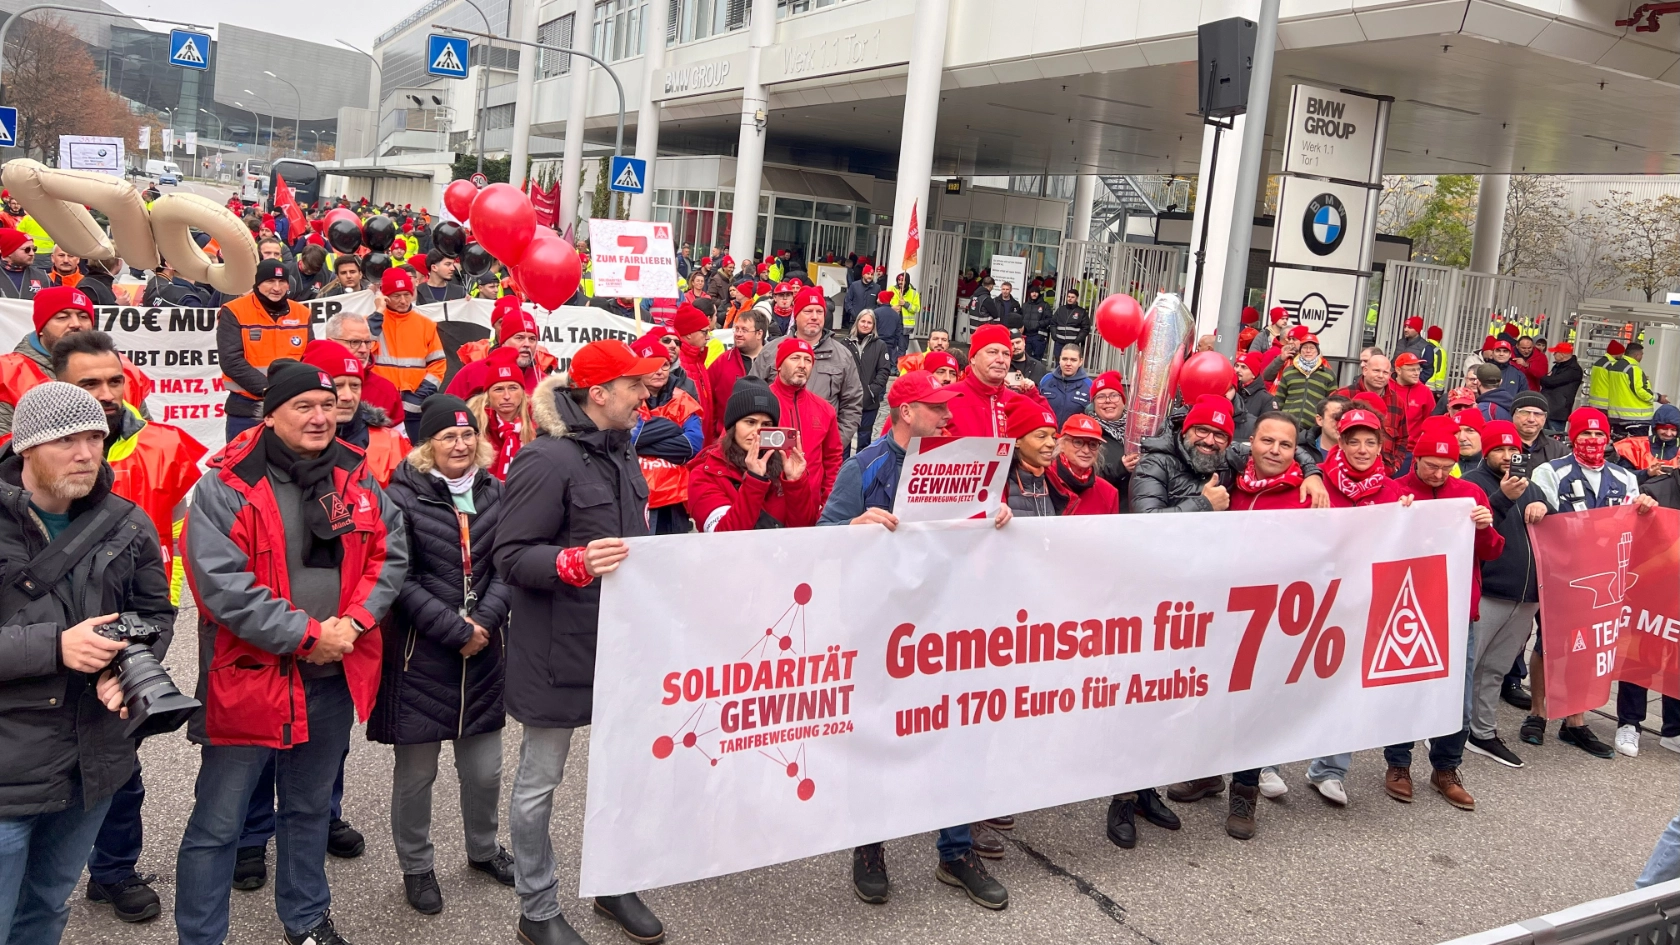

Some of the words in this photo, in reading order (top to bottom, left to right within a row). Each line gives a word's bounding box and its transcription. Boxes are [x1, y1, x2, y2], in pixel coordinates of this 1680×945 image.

[784, 42, 815, 74] Werk
[821, 38, 840, 69] 1.1
[845, 33, 868, 64] Tor
[874, 29, 881, 59] 1
[665, 68, 691, 93] BMW
[692, 60, 730, 90] GROUP
[1306, 97, 1346, 119] BMW
[1304, 116, 1356, 139] GROUP
[1302, 140, 1321, 153] Werk
[1324, 144, 1334, 155] 1.1
[1301, 154, 1313, 166] Tor
[1315, 157, 1319, 166] 1
[1310, 194, 1347, 216] BMW
[596, 254, 617, 263] ZUM
[619, 255, 672, 265] FAIRLIEBEN
[617, 235, 648, 281] 7
[168, 308, 217, 332] MU
[1301, 308, 1325, 321] MINI
[165, 350, 203, 366] DER
[160, 378, 208, 395] HATZ,
[163, 404, 210, 422] JETZT
[911, 461, 985, 476] SOLIDARITÄT
[907, 477, 981, 495] GEWINNT
[907, 495, 957, 503] TARIFBEWEGUNG
[958, 495, 975, 503] JETZT
[331, 518, 355, 531] Münch
[885, 608, 1143, 679] Gemeinsam
[1153, 600, 1214, 651] für
[1227, 578, 1346, 693] 7%
[1592, 617, 1619, 648] TEA
[661, 644, 858, 706] SOLIDARITÄT
[720, 684, 855, 734] GEWINNT
[895, 695, 949, 737] und
[956, 688, 1007, 726] 170
[1014, 685, 1076, 719] Euro
[1082, 676, 1121, 709] für
[1125, 666, 1209, 705] Azubis
[719, 724, 820, 754] TARIFBEWEGUNG
[822, 720, 854, 736] 2024
